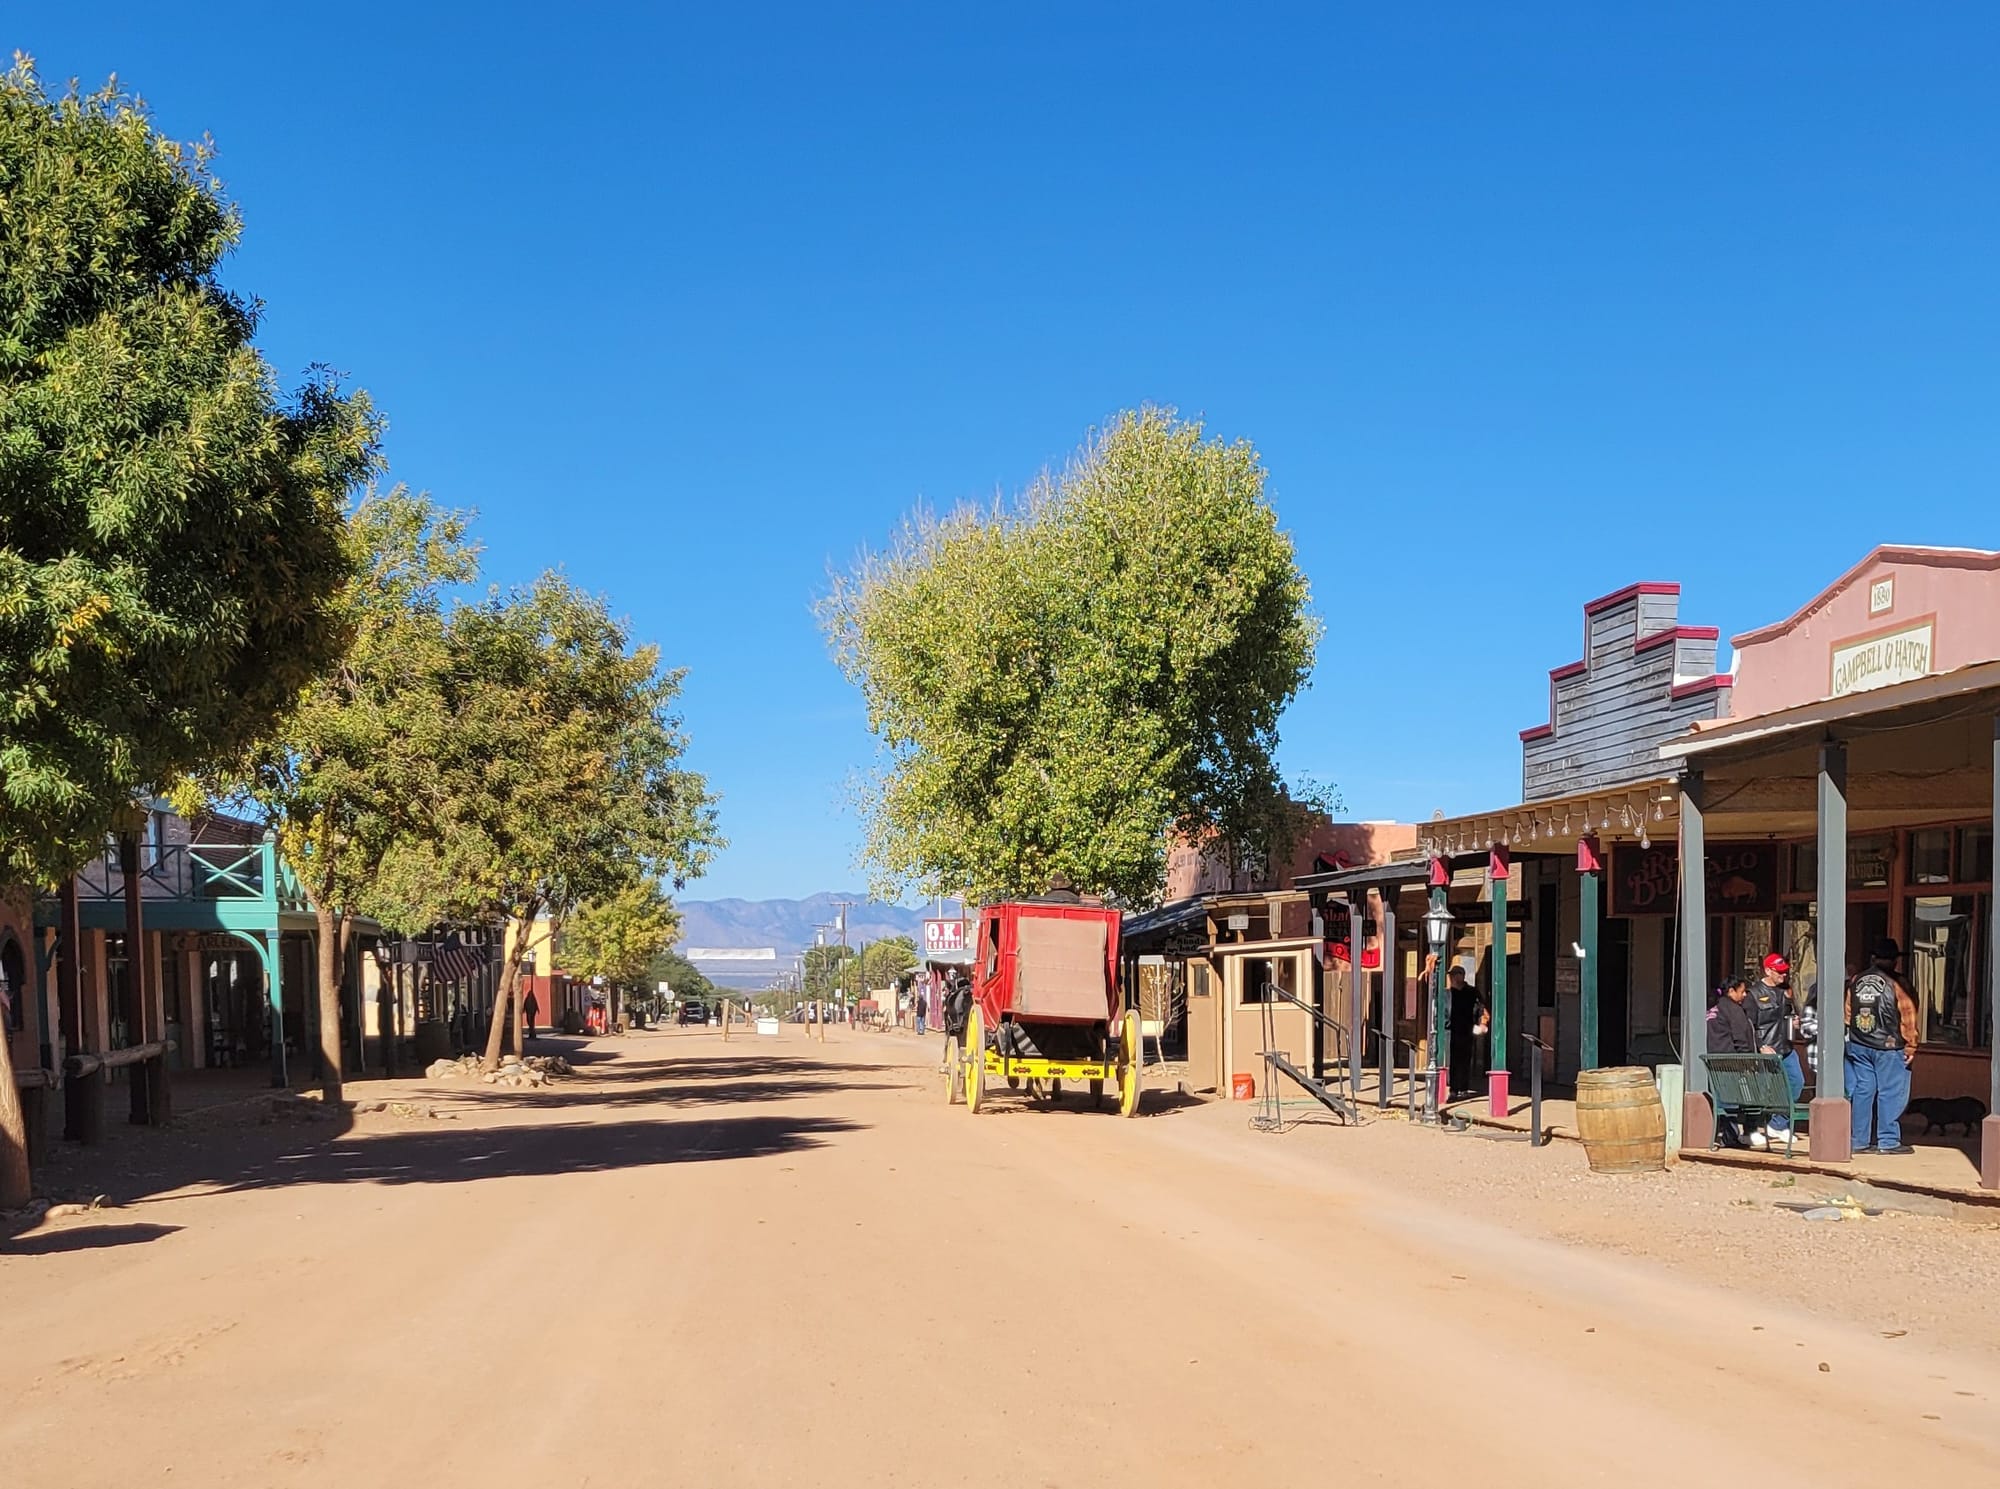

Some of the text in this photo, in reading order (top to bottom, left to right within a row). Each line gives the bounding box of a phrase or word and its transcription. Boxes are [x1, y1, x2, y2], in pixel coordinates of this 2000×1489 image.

[1835, 644, 1883, 693] CAMPBELL
[1895, 639, 1929, 674] HATCH
[928, 923, 960, 941] O.K.
